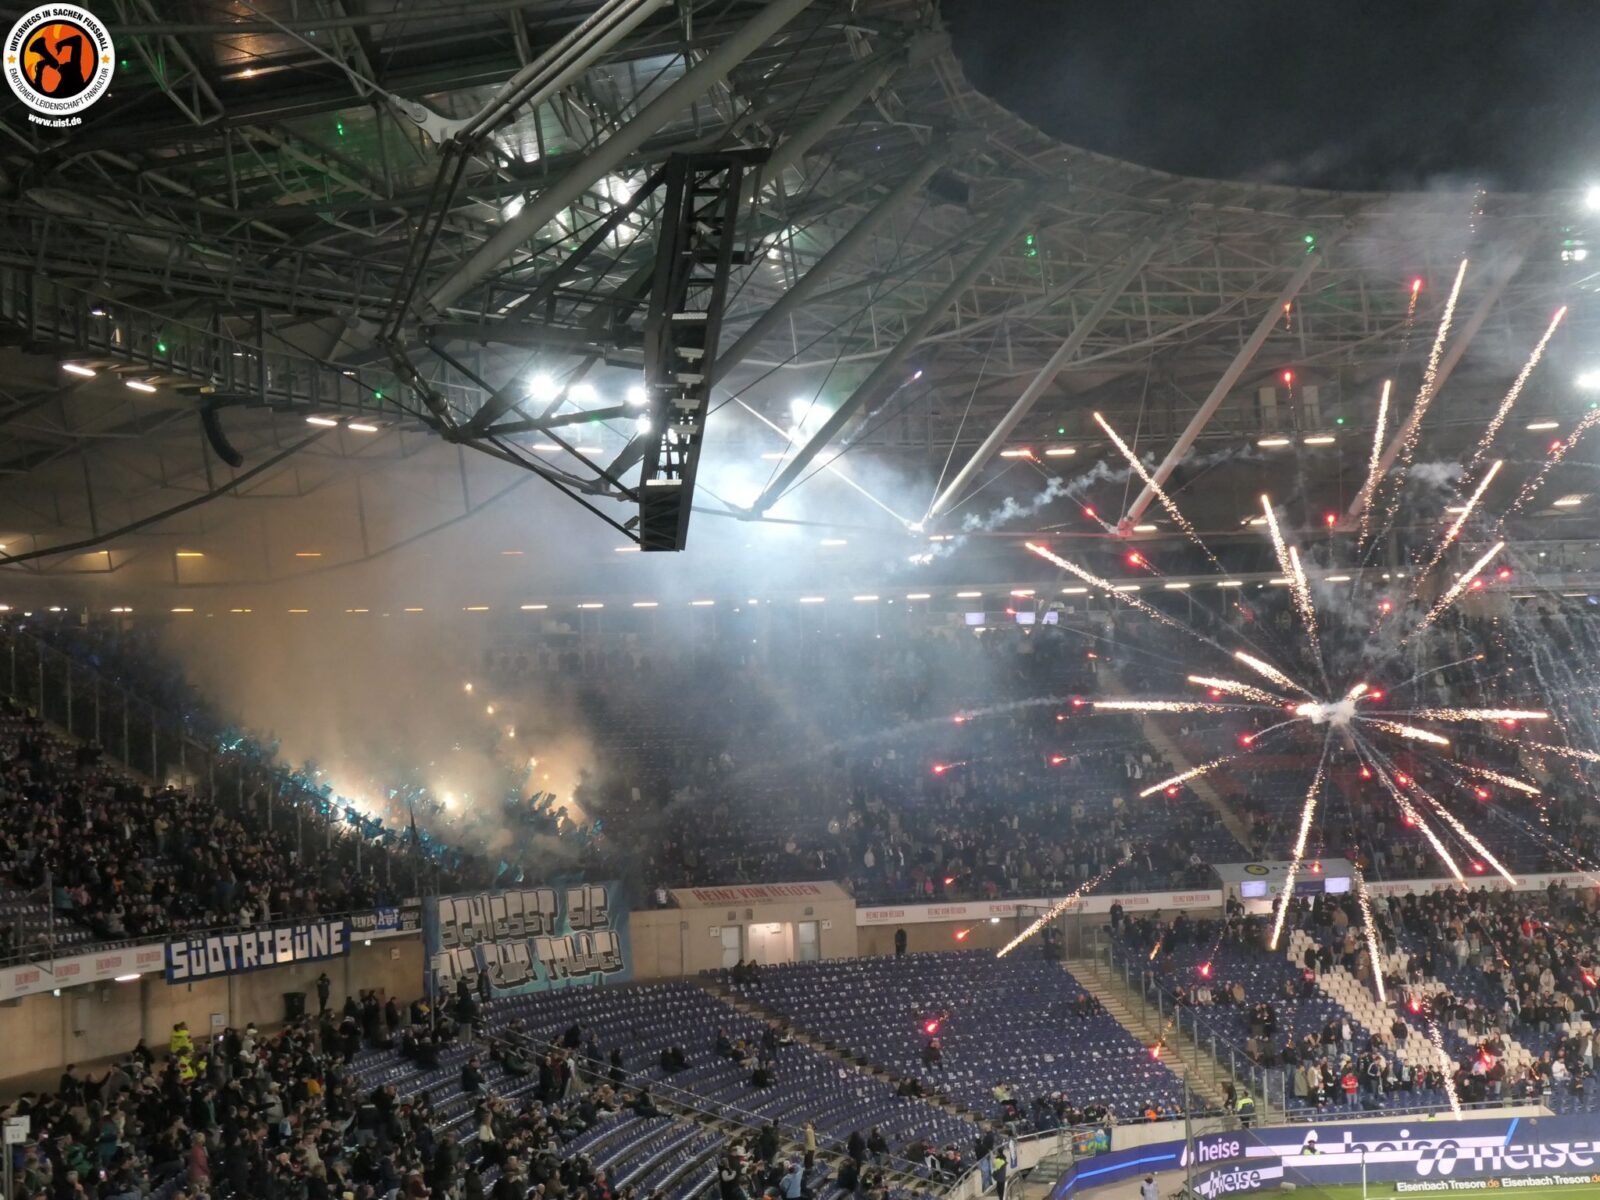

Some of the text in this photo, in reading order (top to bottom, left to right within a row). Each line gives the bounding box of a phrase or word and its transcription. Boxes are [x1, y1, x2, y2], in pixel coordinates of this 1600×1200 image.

[437, 885, 608, 949] SCHIESST SIE
[170, 921, 344, 979] SÜDTRIBÜNE
[483, 944, 538, 988] ZUR
[1199, 1138, 1240, 1162] heise
[1397, 1180, 1449, 1192] Eisenbach
[1502, 1176, 1553, 1188] Eisenbach
